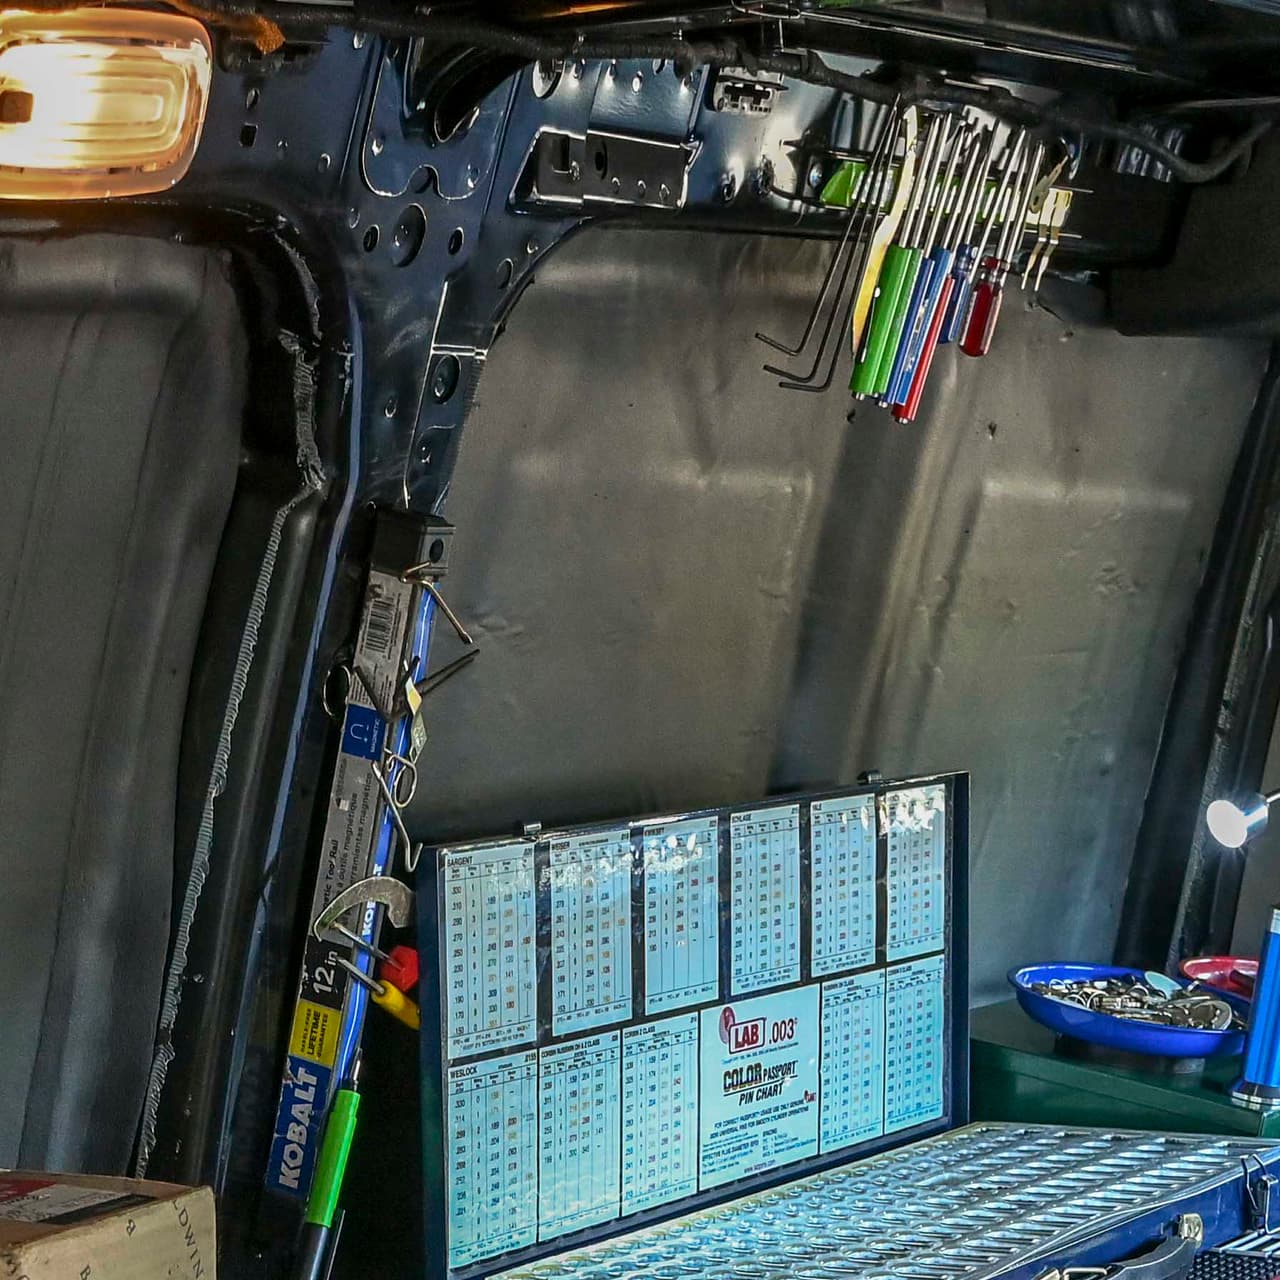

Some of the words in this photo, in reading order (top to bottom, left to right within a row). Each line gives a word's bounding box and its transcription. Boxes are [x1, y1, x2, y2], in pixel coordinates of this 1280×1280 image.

[338, 853, 348, 880] outils
[344, 793, 357, 850] magnétique
[351, 827, 363, 884] erramientas
[358, 772, 372, 824] magnético
[329, 840, 339, 859] Rail
[447, 856, 473, 867] SARGENT
[313, 968, 335, 993] 12
[325, 950, 338, 966] in
[307, 1010, 321, 1055] LIFETIME
[316, 1013, 329, 1058] GUARANTEE
[734, 1024, 759, 1049] LAB
[450, 1066, 477, 1079] WESLOCK
[723, 1063, 762, 1092] COLOR
[739, 1090, 754, 1106] PIN
[756, 1080, 784, 1103] CHART
[278, 1066, 318, 1189] KOBALT
